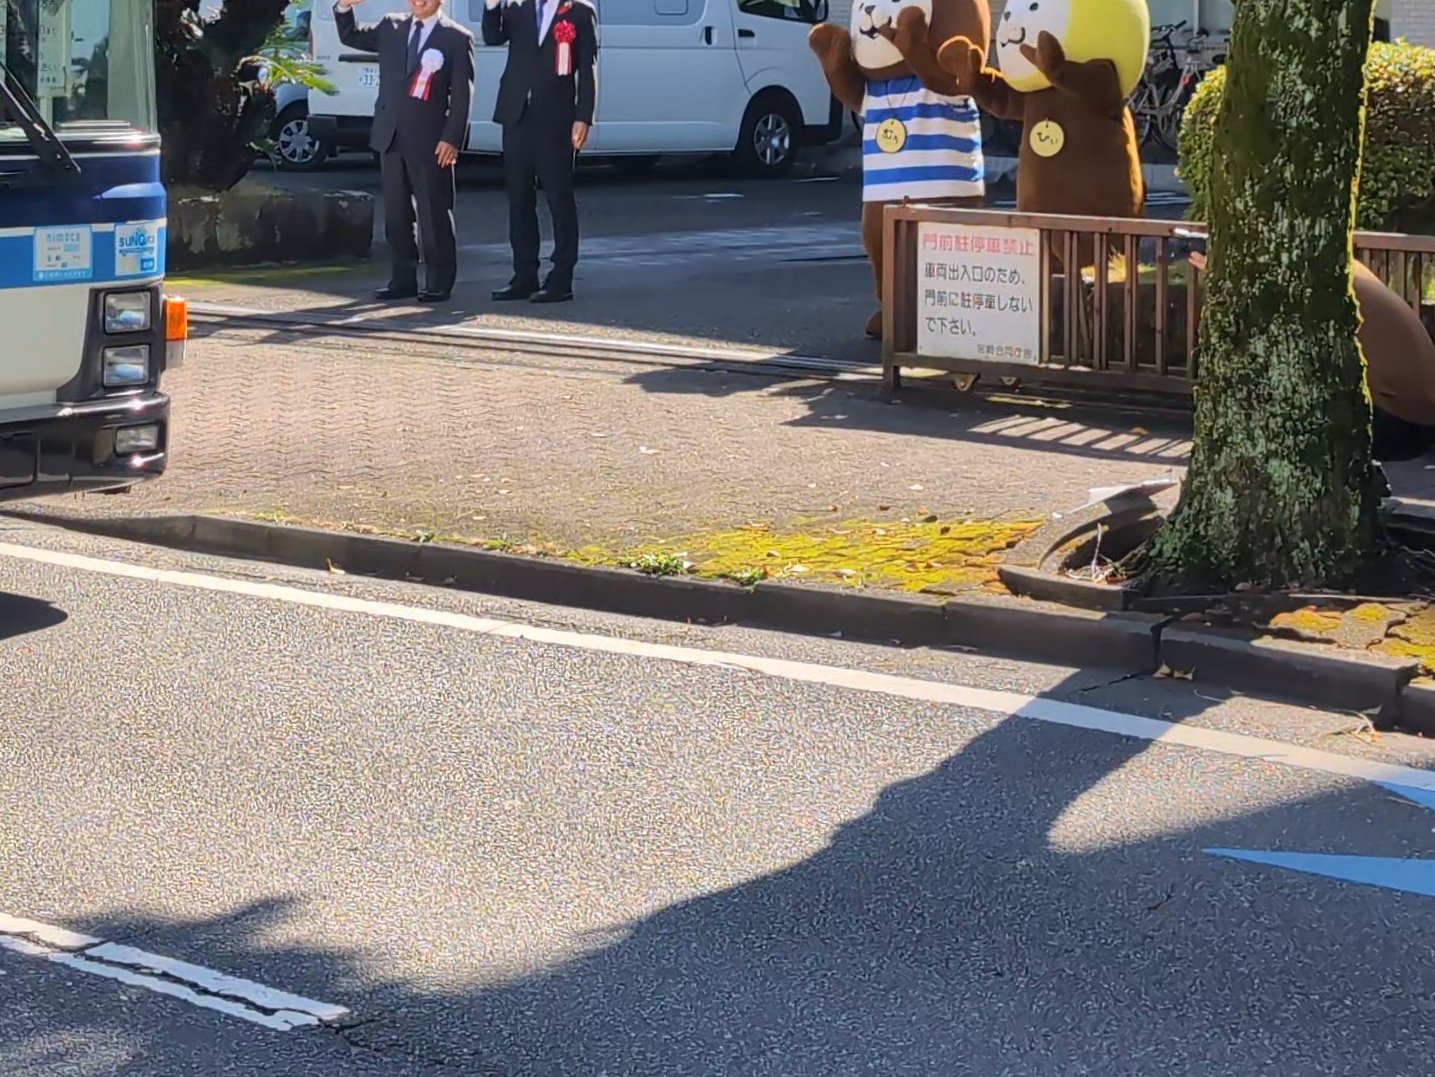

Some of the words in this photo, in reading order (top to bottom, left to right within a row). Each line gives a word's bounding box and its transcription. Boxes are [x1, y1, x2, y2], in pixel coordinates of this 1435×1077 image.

[923, 232, 1035, 257] 門前駐停車禁止
[924, 289, 1033, 312] 門前に駐停車しない
